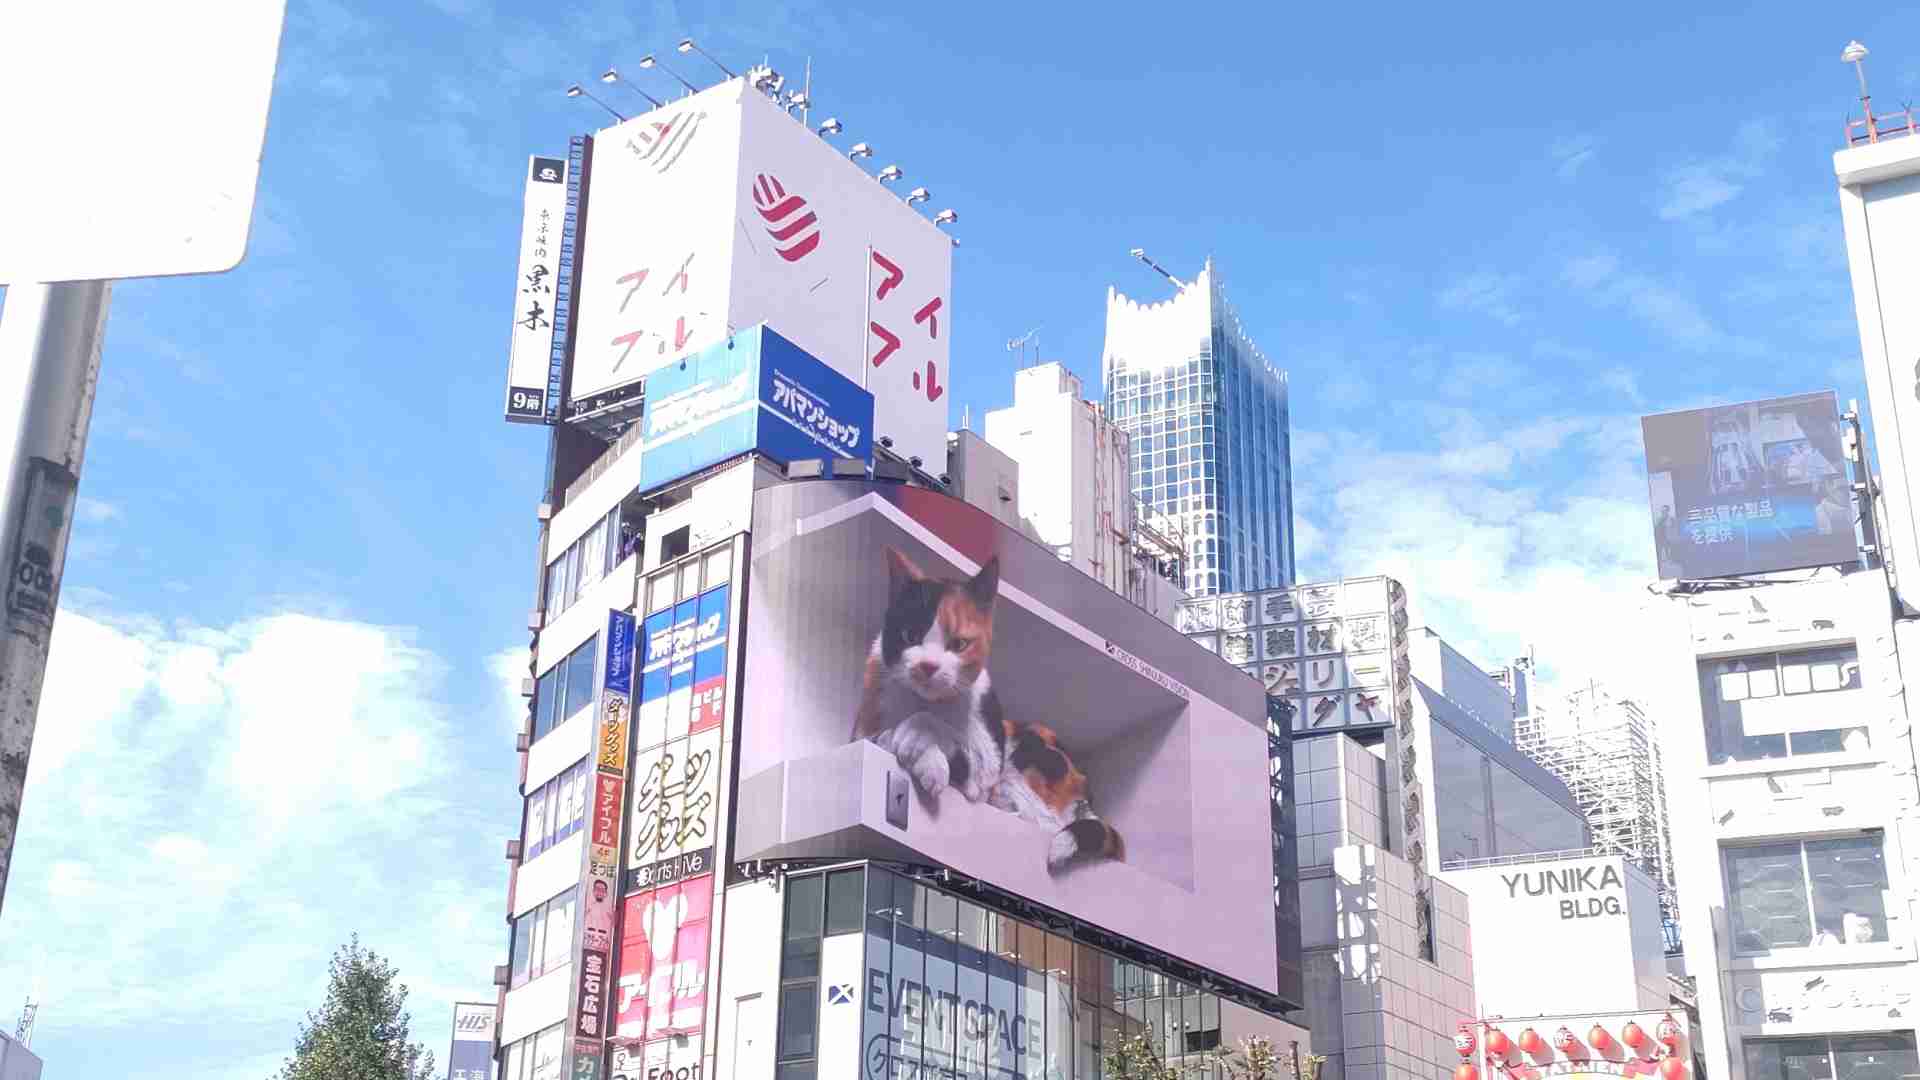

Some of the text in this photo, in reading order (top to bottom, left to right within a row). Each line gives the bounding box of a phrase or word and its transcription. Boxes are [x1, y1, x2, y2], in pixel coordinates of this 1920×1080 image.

[773, 379, 860, 447] アパマンショップ
[1501, 863, 1623, 898] YUNIKA
[1559, 895, 1627, 921] BLDG.
[868, 967, 1041, 1059] EVENT SPACE
